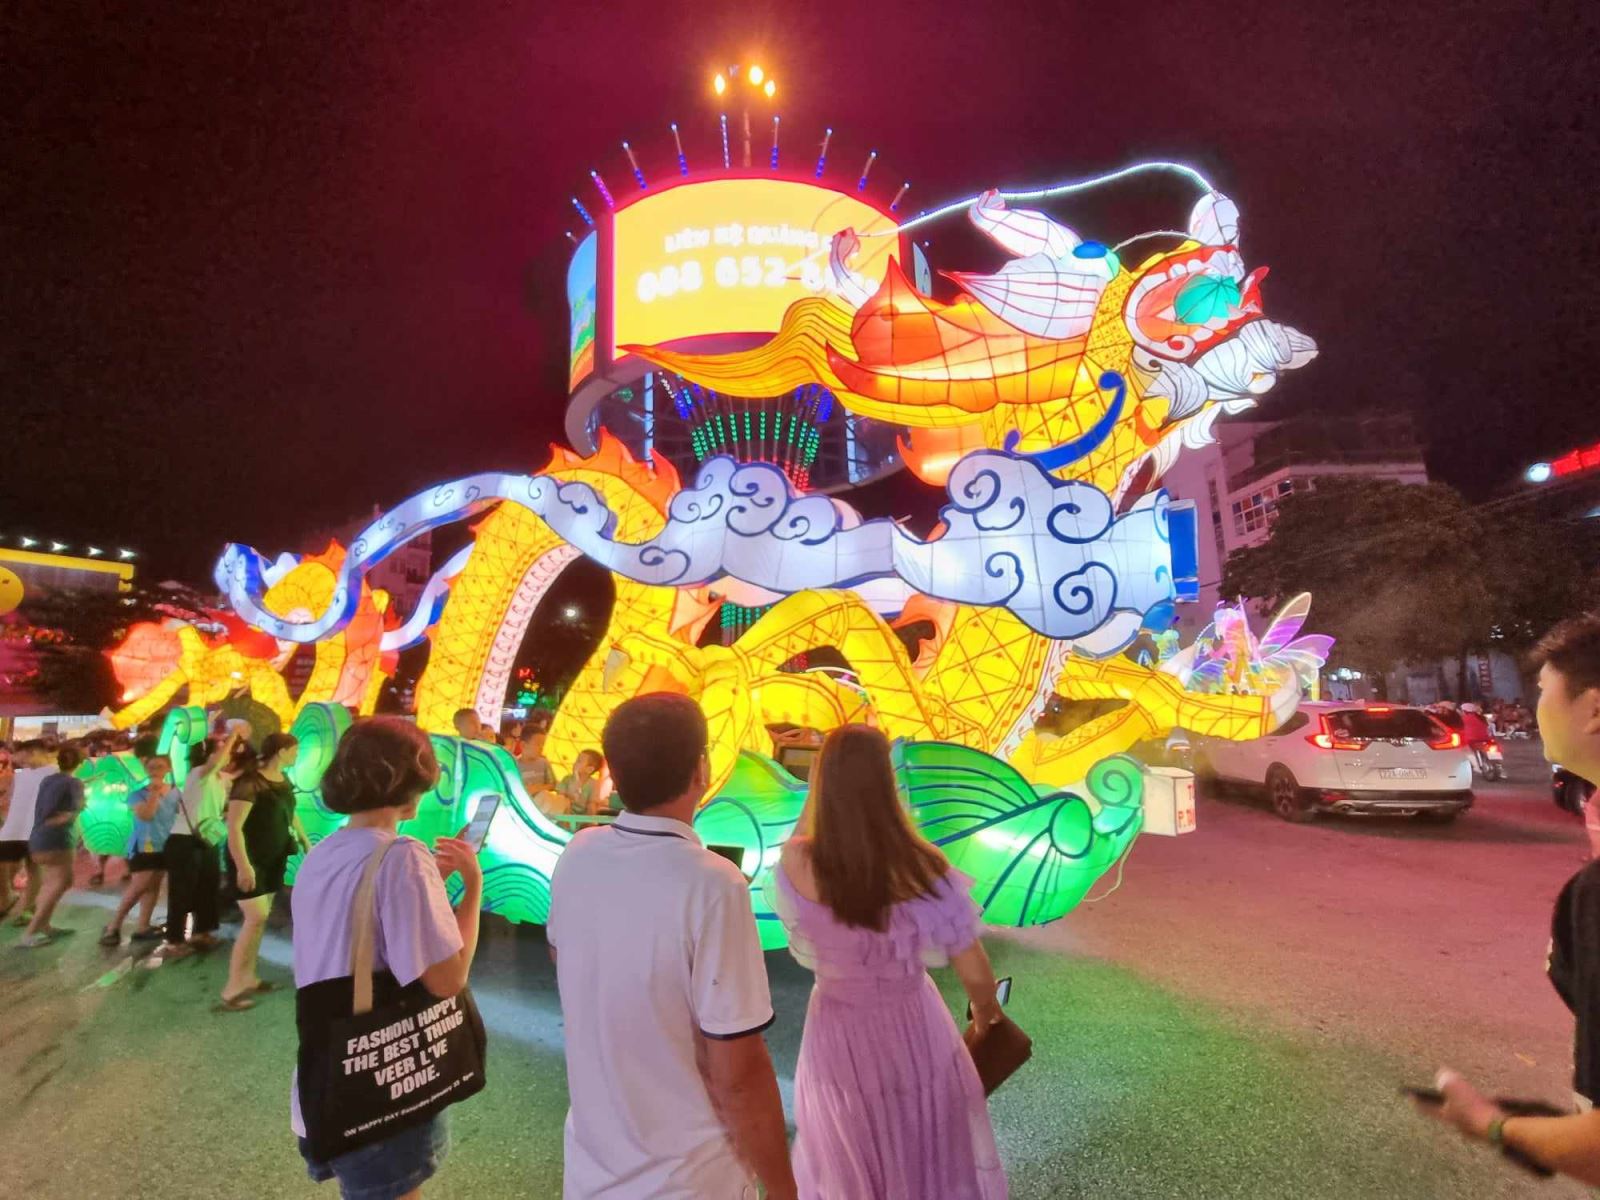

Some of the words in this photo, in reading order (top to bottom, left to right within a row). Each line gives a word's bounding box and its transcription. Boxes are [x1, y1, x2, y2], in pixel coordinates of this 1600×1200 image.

[341, 1050, 379, 1076] THE
[383, 1032, 420, 1063] BEST
[423, 1009, 463, 1043] THING
[347, 1016, 414, 1056] FASHION
[417, 995, 457, 1028] HAPPY
[374, 1056, 416, 1087] VEER
[390, 1064, 440, 1100] DONE.
